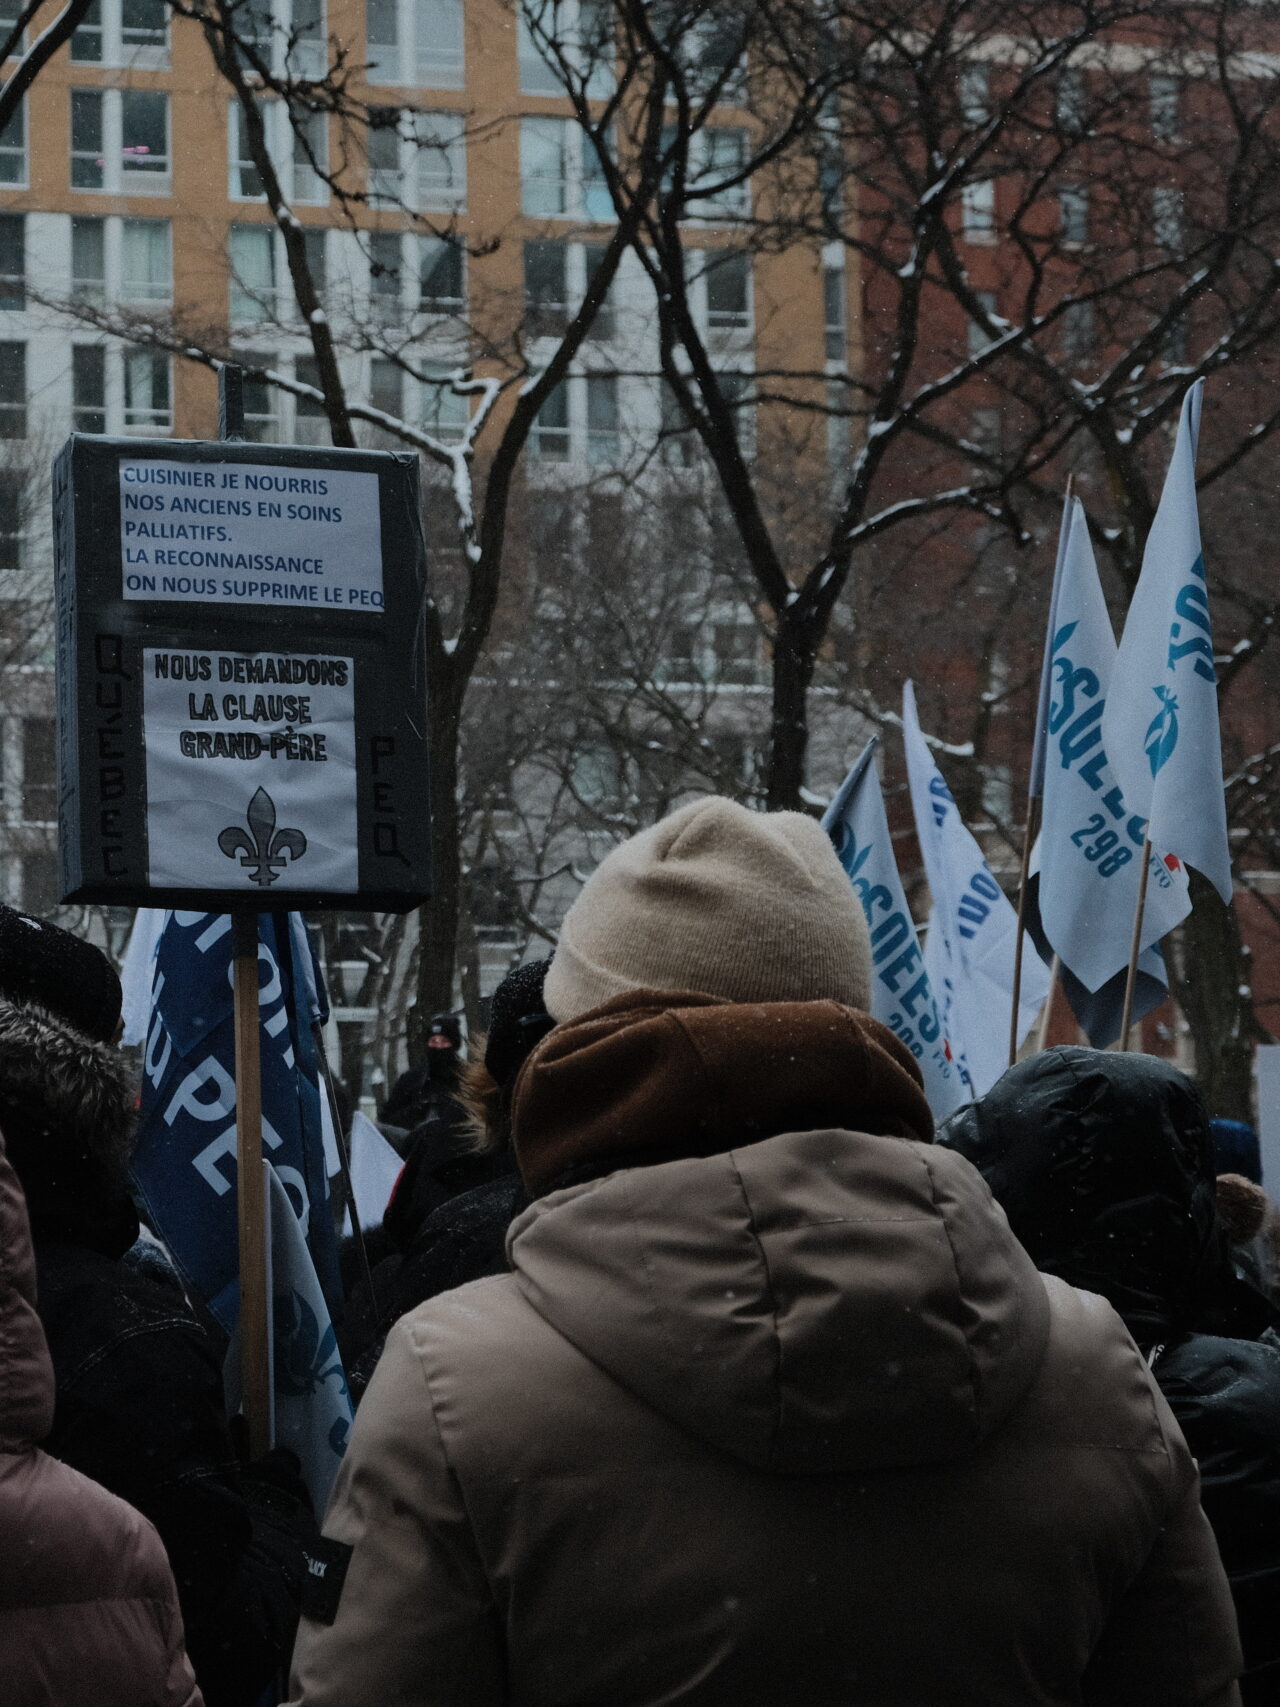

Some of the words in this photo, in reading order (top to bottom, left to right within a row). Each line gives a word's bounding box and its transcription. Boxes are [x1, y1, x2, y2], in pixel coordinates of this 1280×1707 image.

[124, 467, 215, 488] CUISINIER
[221, 474, 239, 489] JE
[245, 474, 328, 495] NOURRIS
[125, 494, 164, 511] NOS
[170, 497, 252, 517] ANCIENS
[258, 502, 281, 518] EN
[287, 504, 342, 523] SOINS
[126, 521, 232, 541] PALLIATIFS.
[126, 548, 148, 564] LA
[155, 549, 324, 575] RECONNAISSANCE
[126, 575, 156, 592] ON
[162, 577, 217, 595] NOUS
[222, 580, 318, 601] SUPPRIME
[324, 586, 342, 603] LE
[348, 589, 385, 608] PEQ
[155, 654, 211, 681] NOUS
[219, 658, 348, 686] DEMANDONS
[189, 693, 217, 721] LA
[222, 694, 312, 724] CLAUSE
[180, 726, 328, 761] GRAND-PÈRE
[1071, 813, 1132, 878] 298
